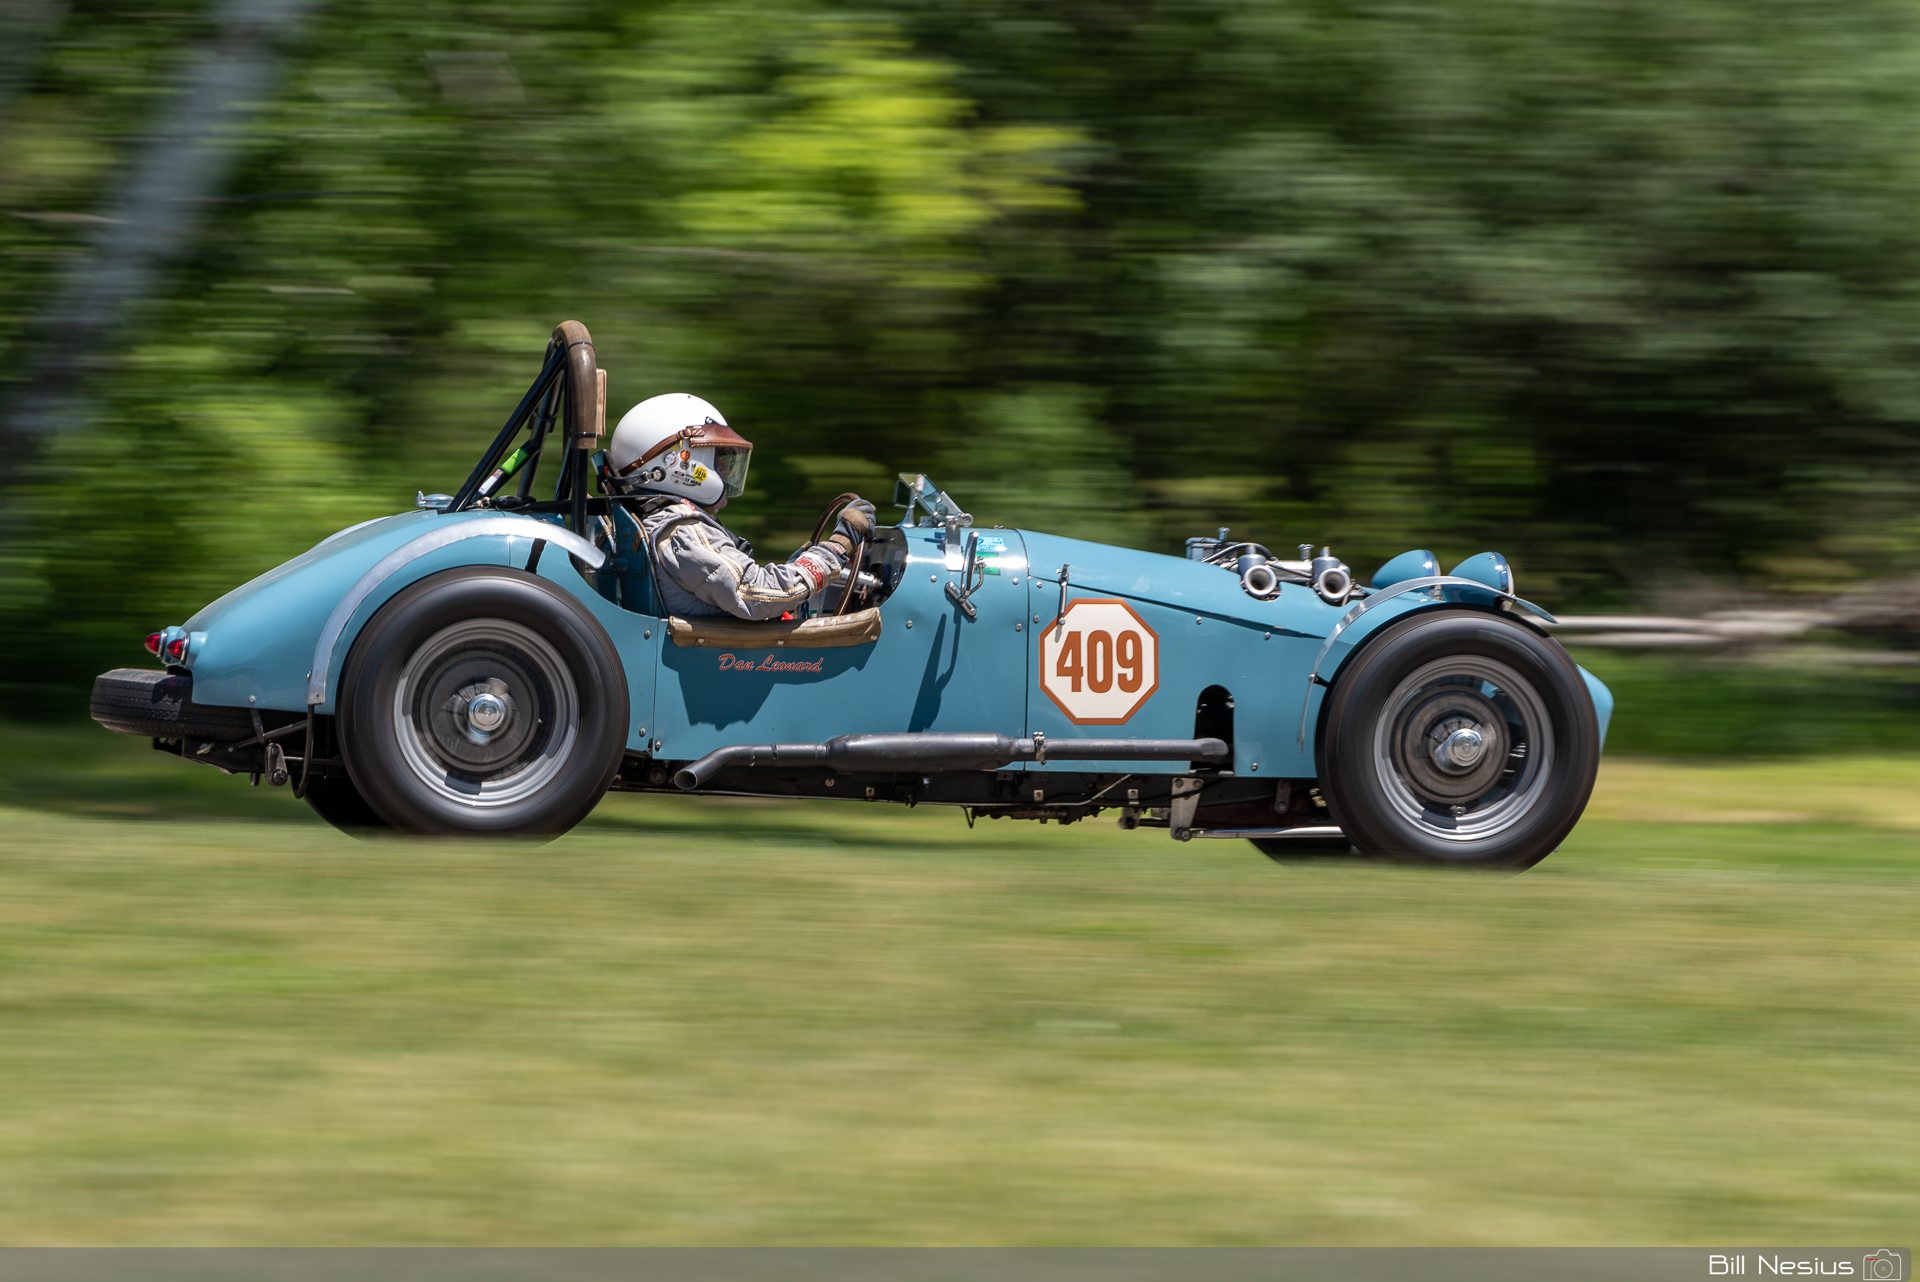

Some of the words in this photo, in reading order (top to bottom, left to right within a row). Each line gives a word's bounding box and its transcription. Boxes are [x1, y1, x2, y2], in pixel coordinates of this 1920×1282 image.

[718, 653, 754, 671] Dan
[755, 654, 824, 672] Leonard
[1056, 630, 1143, 693] 409
